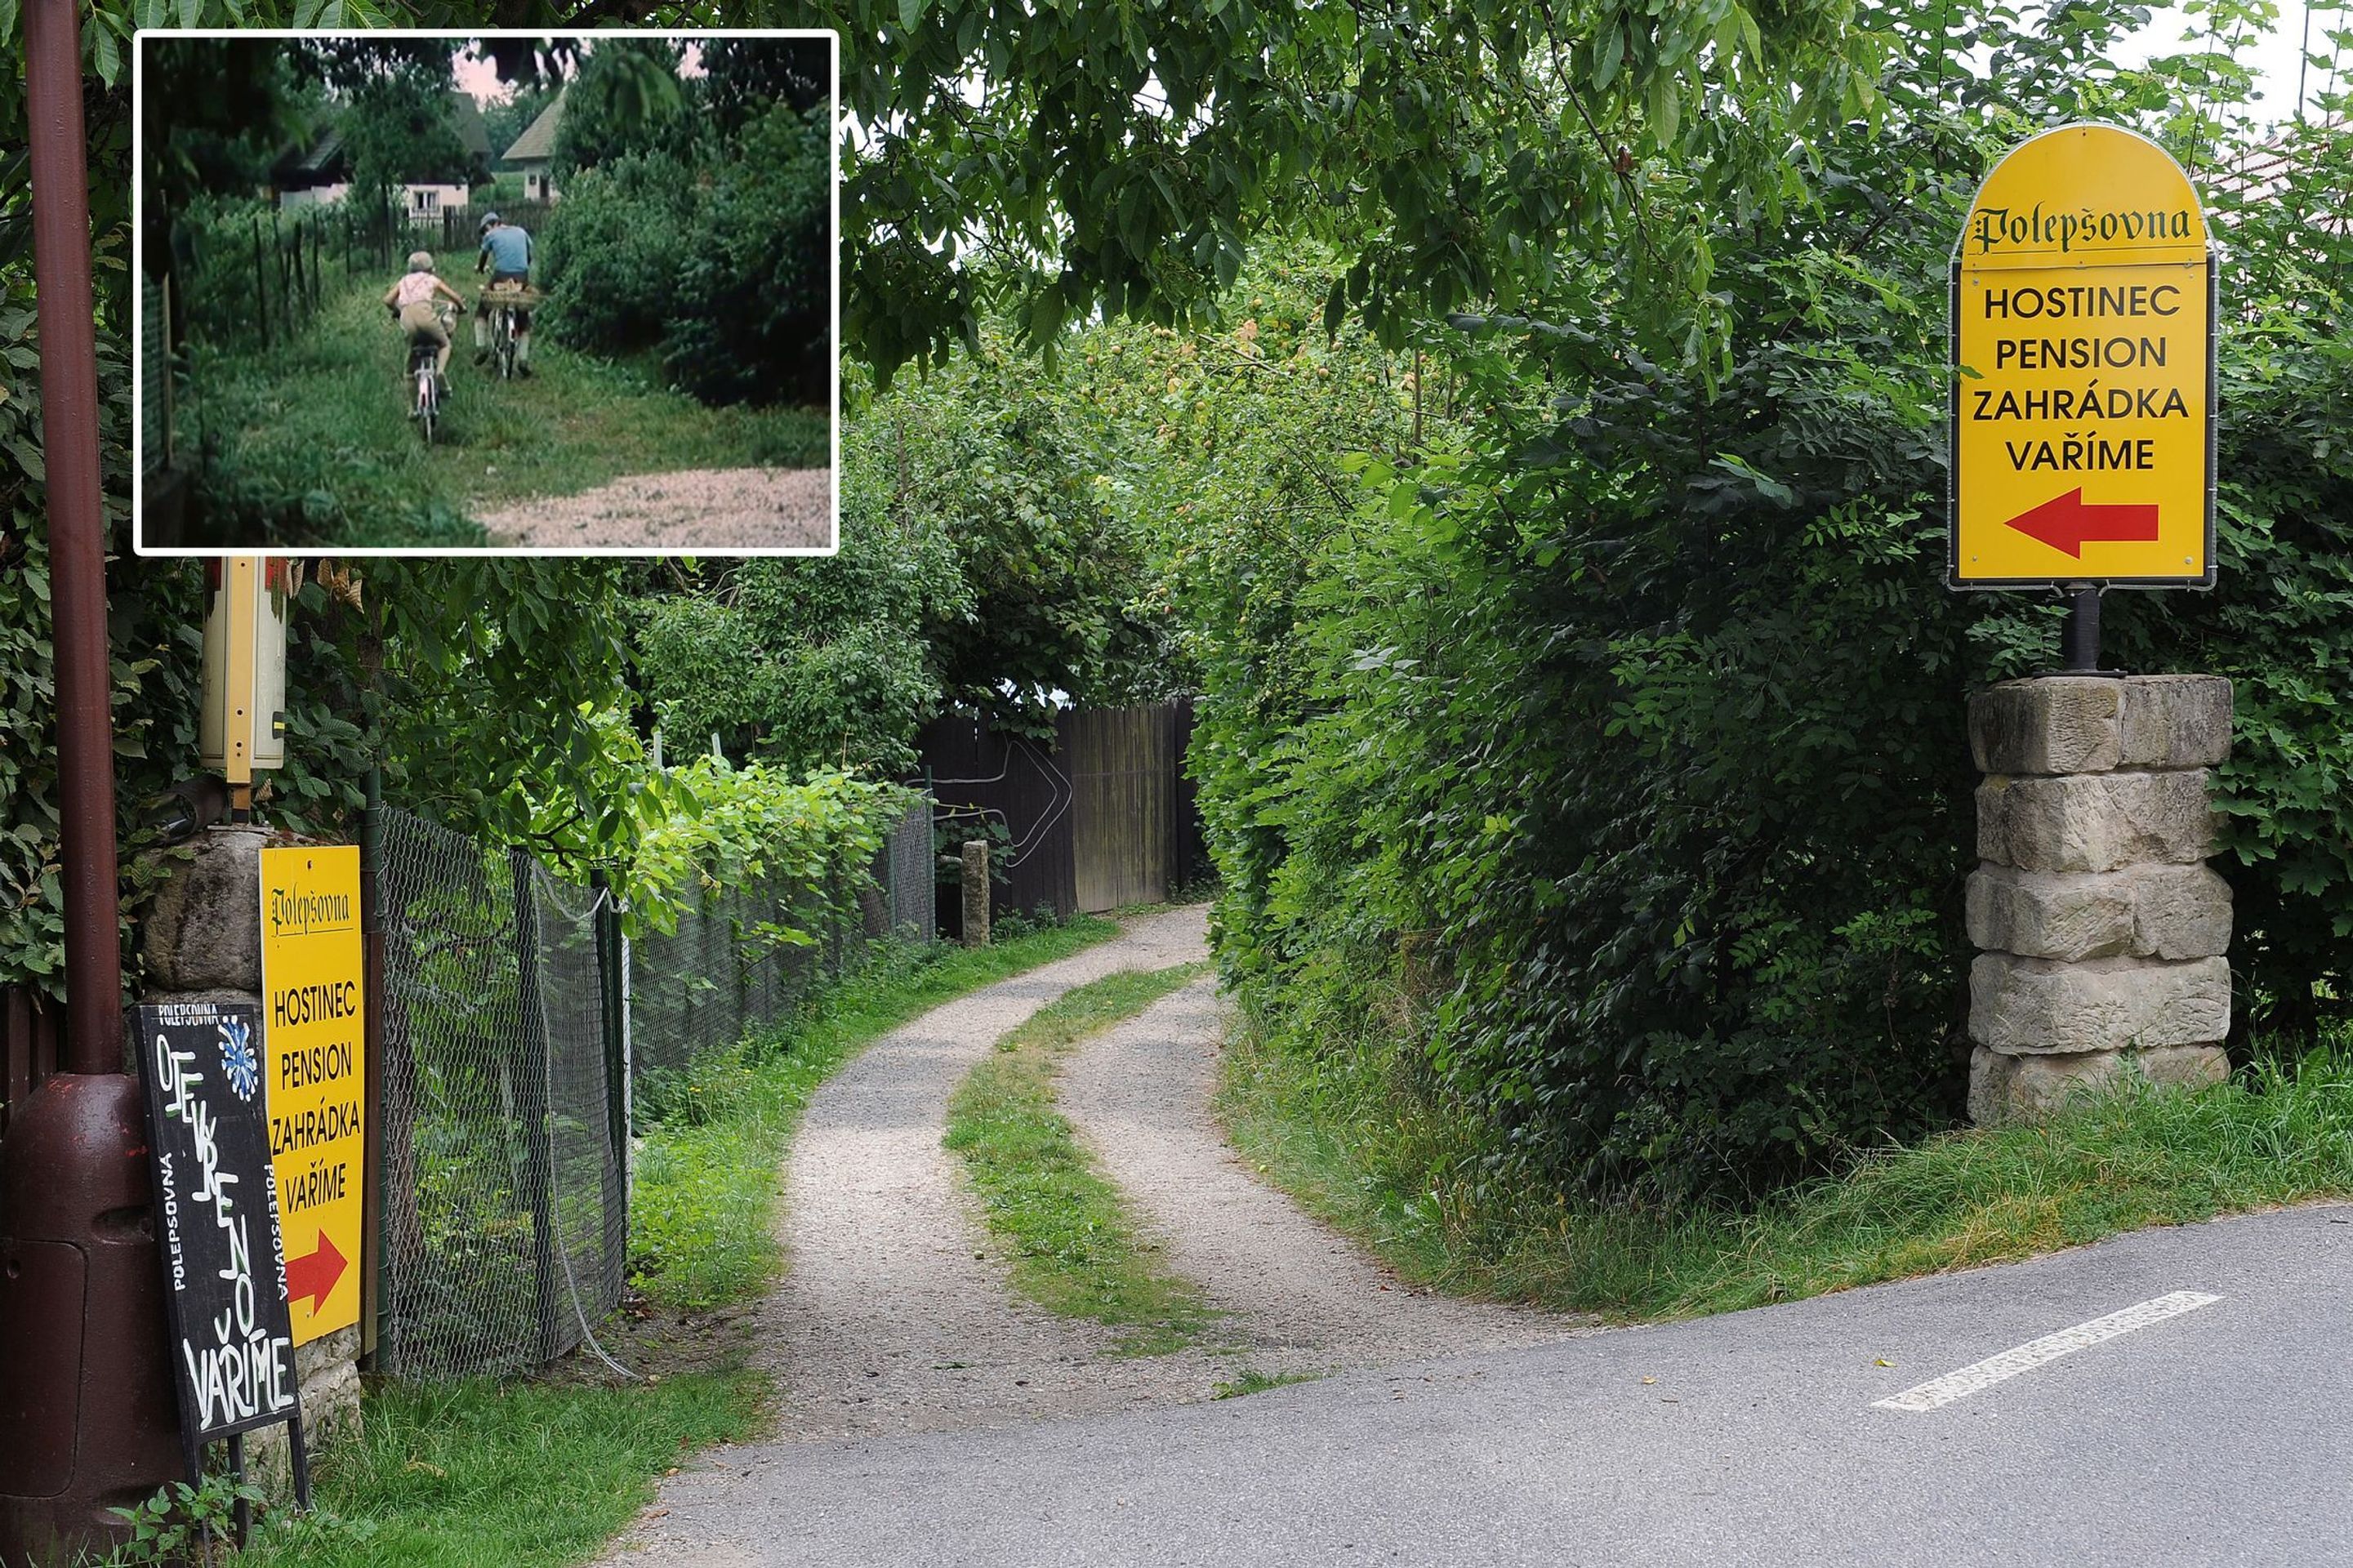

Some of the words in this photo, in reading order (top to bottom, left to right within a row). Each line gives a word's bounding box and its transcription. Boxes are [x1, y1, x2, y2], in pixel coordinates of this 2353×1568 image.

[1973, 200, 2192, 255] Polepšovna
[1985, 285, 2181, 319] HOSTINEC
[1996, 336, 2167, 369] PENSION
[1973, 379, 2189, 421] ZAHRÁDKA
[2005, 431, 2155, 471] VAŘÍME
[271, 883, 350, 937] Polepšovna
[274, 980, 356, 1028] HOSTINEC
[282, 1041, 352, 1090] PENSION
[272, 1096, 361, 1156] ZAHRÁDKA
[285, 1157, 347, 1214] VAŘÍME
[183, 1307, 295, 1431] VAŘÍME
